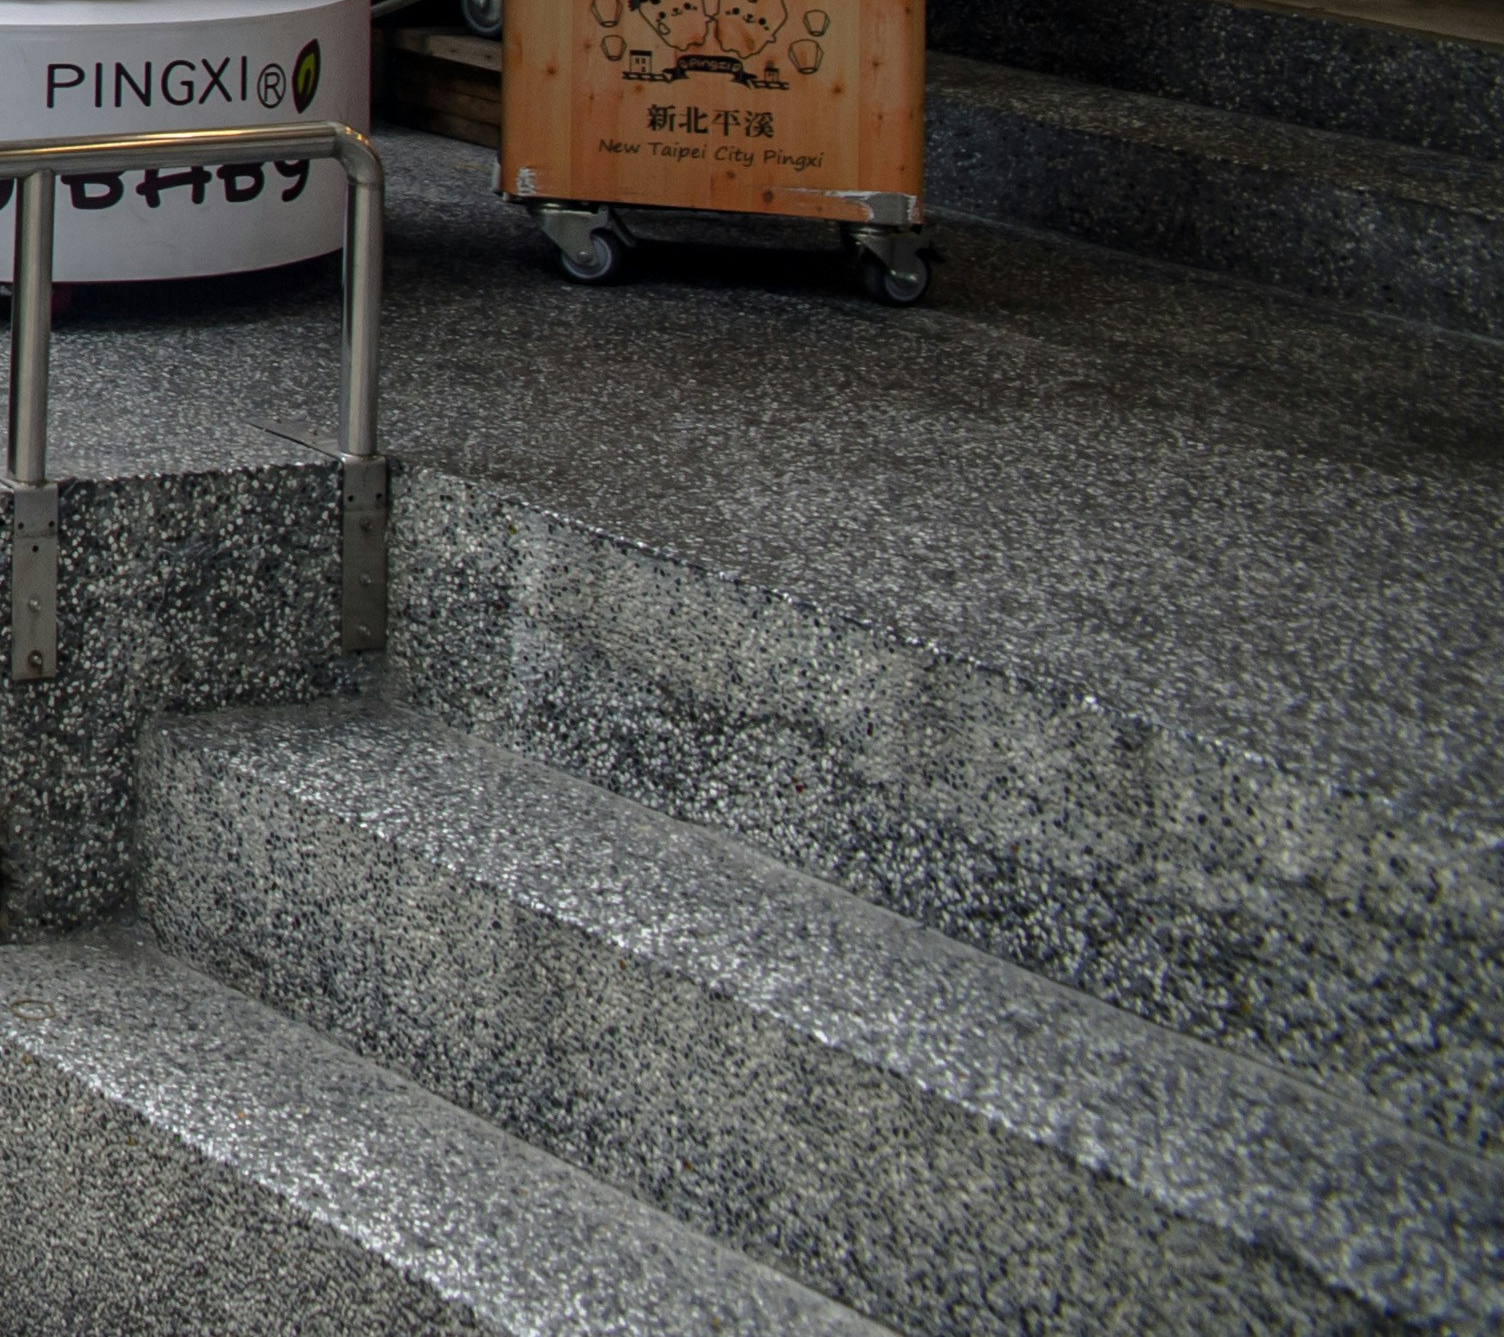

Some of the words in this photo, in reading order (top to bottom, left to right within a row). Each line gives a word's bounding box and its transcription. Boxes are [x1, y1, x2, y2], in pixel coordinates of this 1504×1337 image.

[646, 103, 777, 140] 新北平溪
[598, 138, 640, 158] New
[648, 141, 708, 163] Taipei
[714, 143, 756, 168] City
[762, 147, 824, 171] Pingxi
